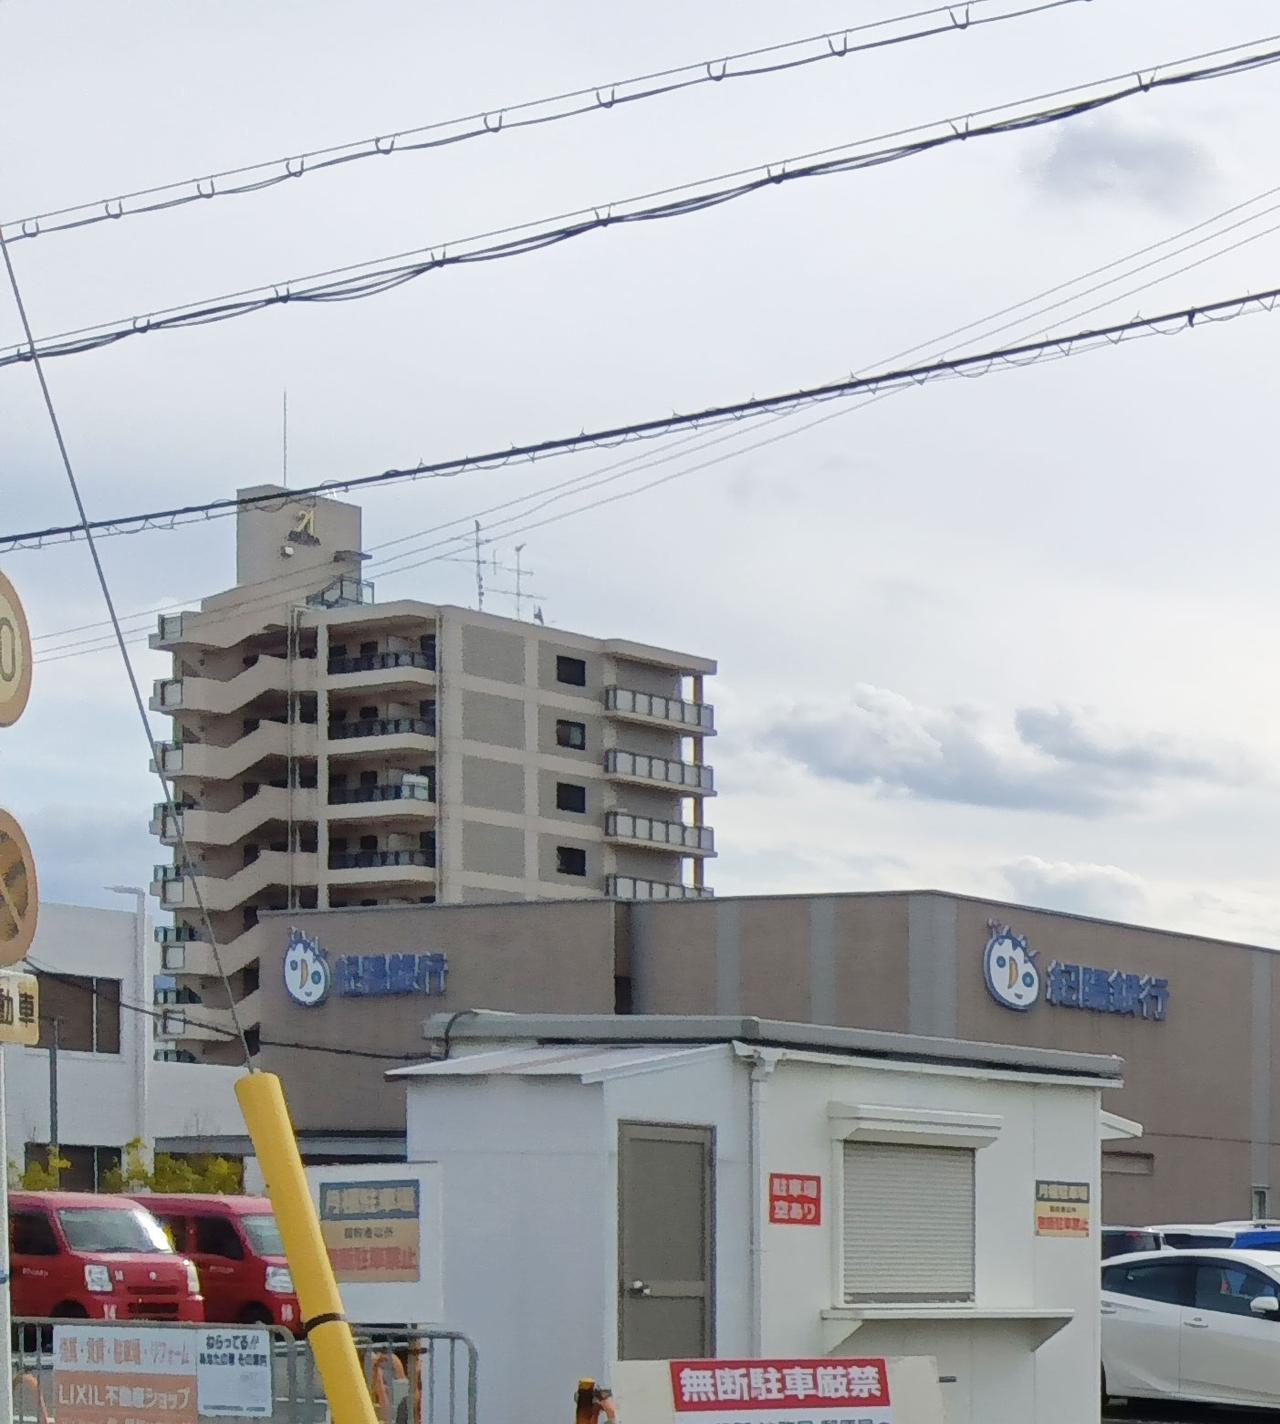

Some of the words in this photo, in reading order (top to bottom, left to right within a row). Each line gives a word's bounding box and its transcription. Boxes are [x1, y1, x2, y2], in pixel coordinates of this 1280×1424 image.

[680, 1365, 882, 1402] 無断駐車厳禁
